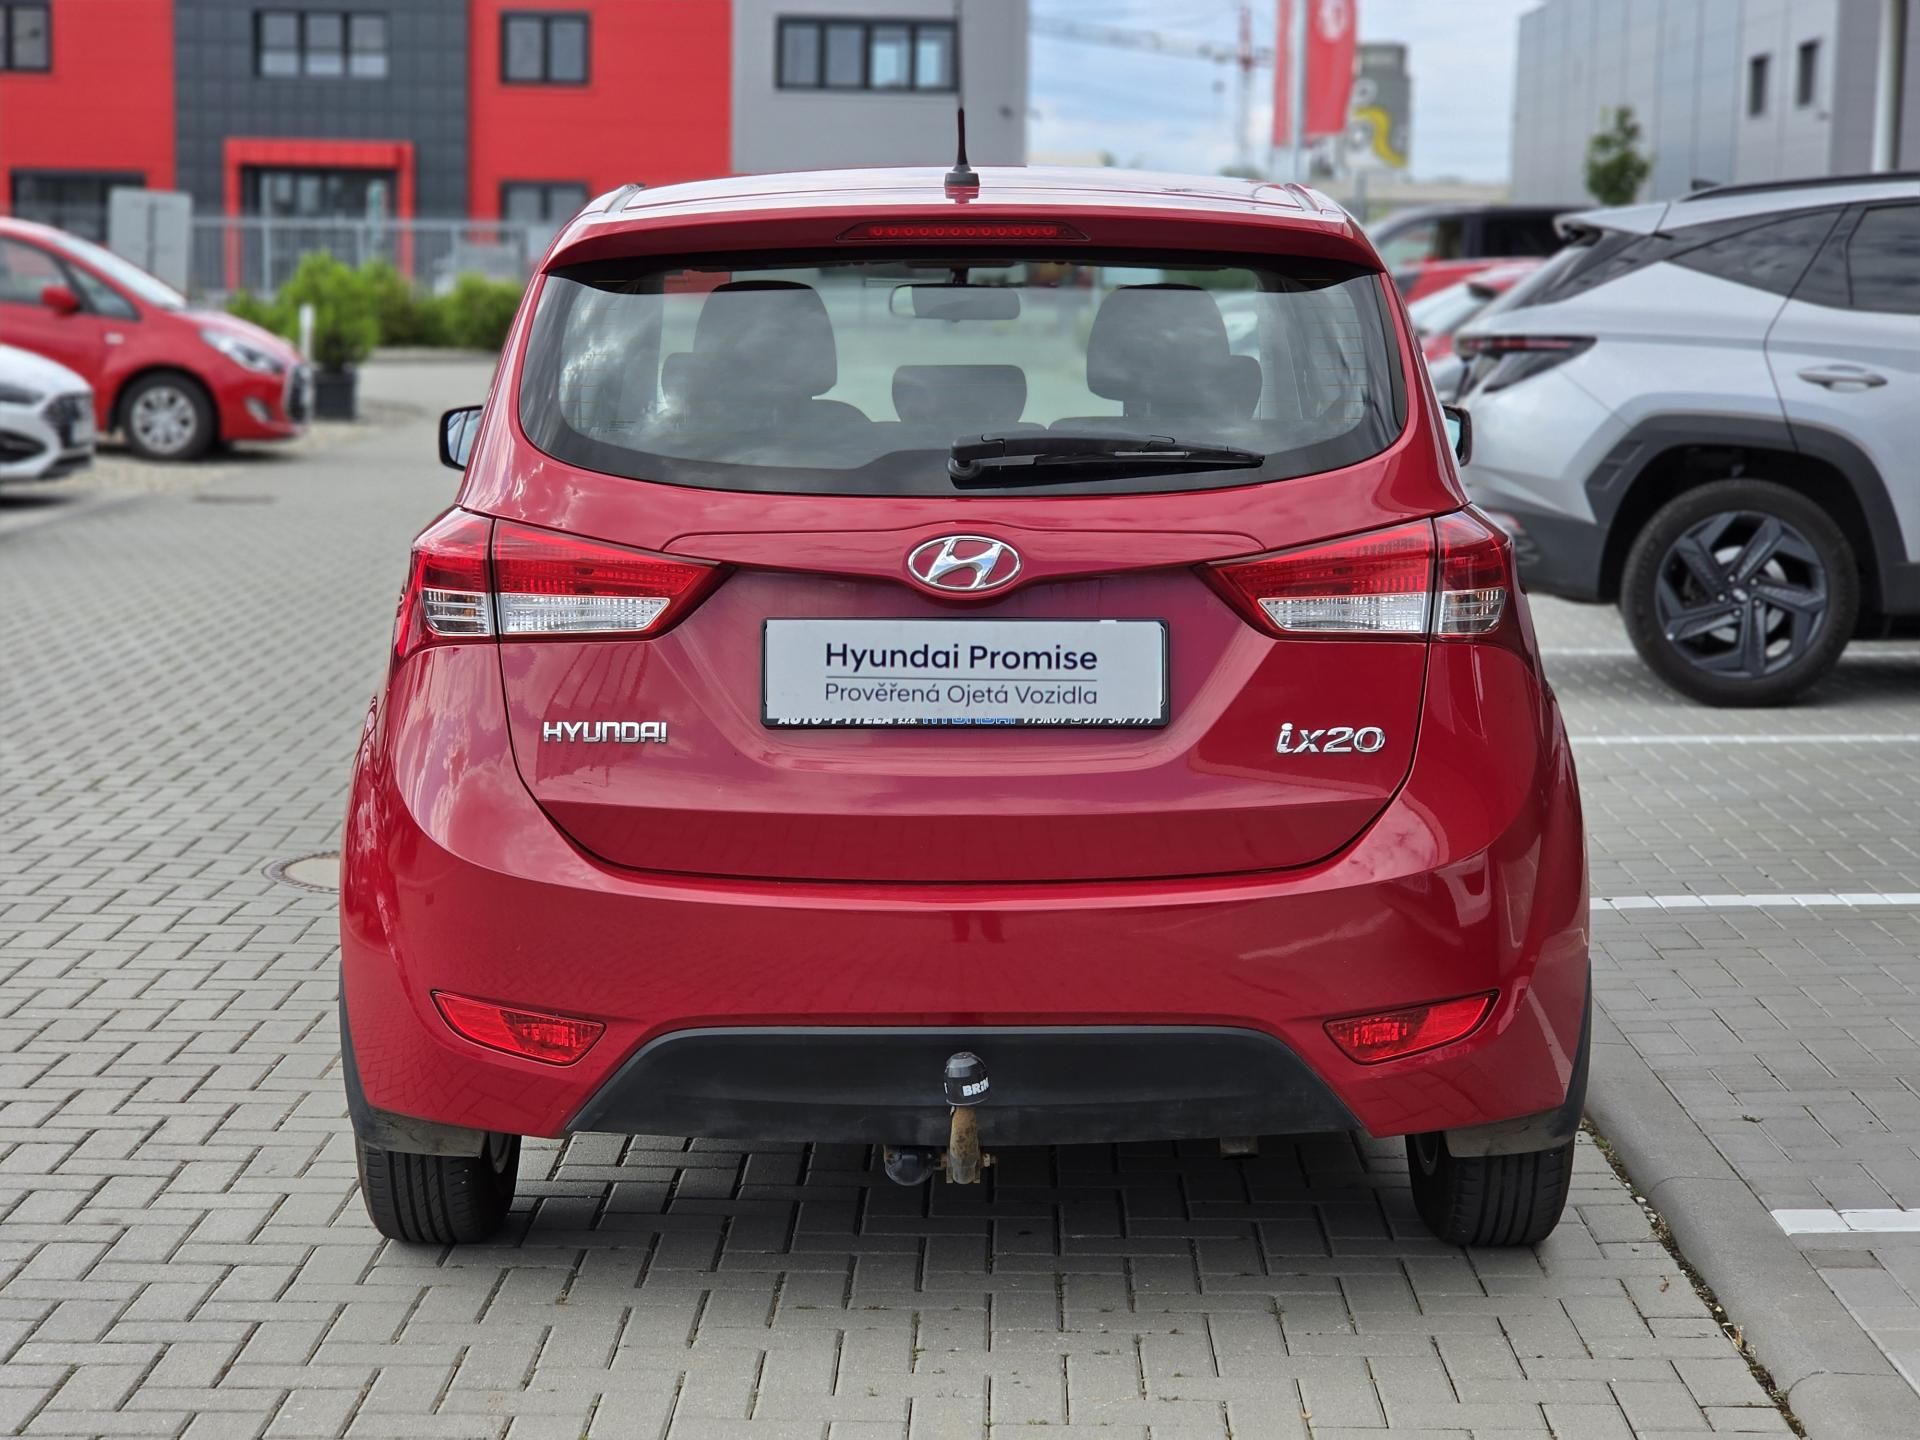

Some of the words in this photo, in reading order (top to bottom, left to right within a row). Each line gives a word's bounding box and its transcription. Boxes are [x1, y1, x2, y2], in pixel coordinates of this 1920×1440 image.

[826, 643, 959, 673] Hyundai
[969, 644, 1098, 670] Promise
[825, 682, 940, 702] Prověřená
[947, 684, 1008, 707] Ojetá
[1015, 685, 1097, 704] Vozidla
[543, 721, 667, 742] HYUNDAI
[1276, 722, 1386, 753] ix20
